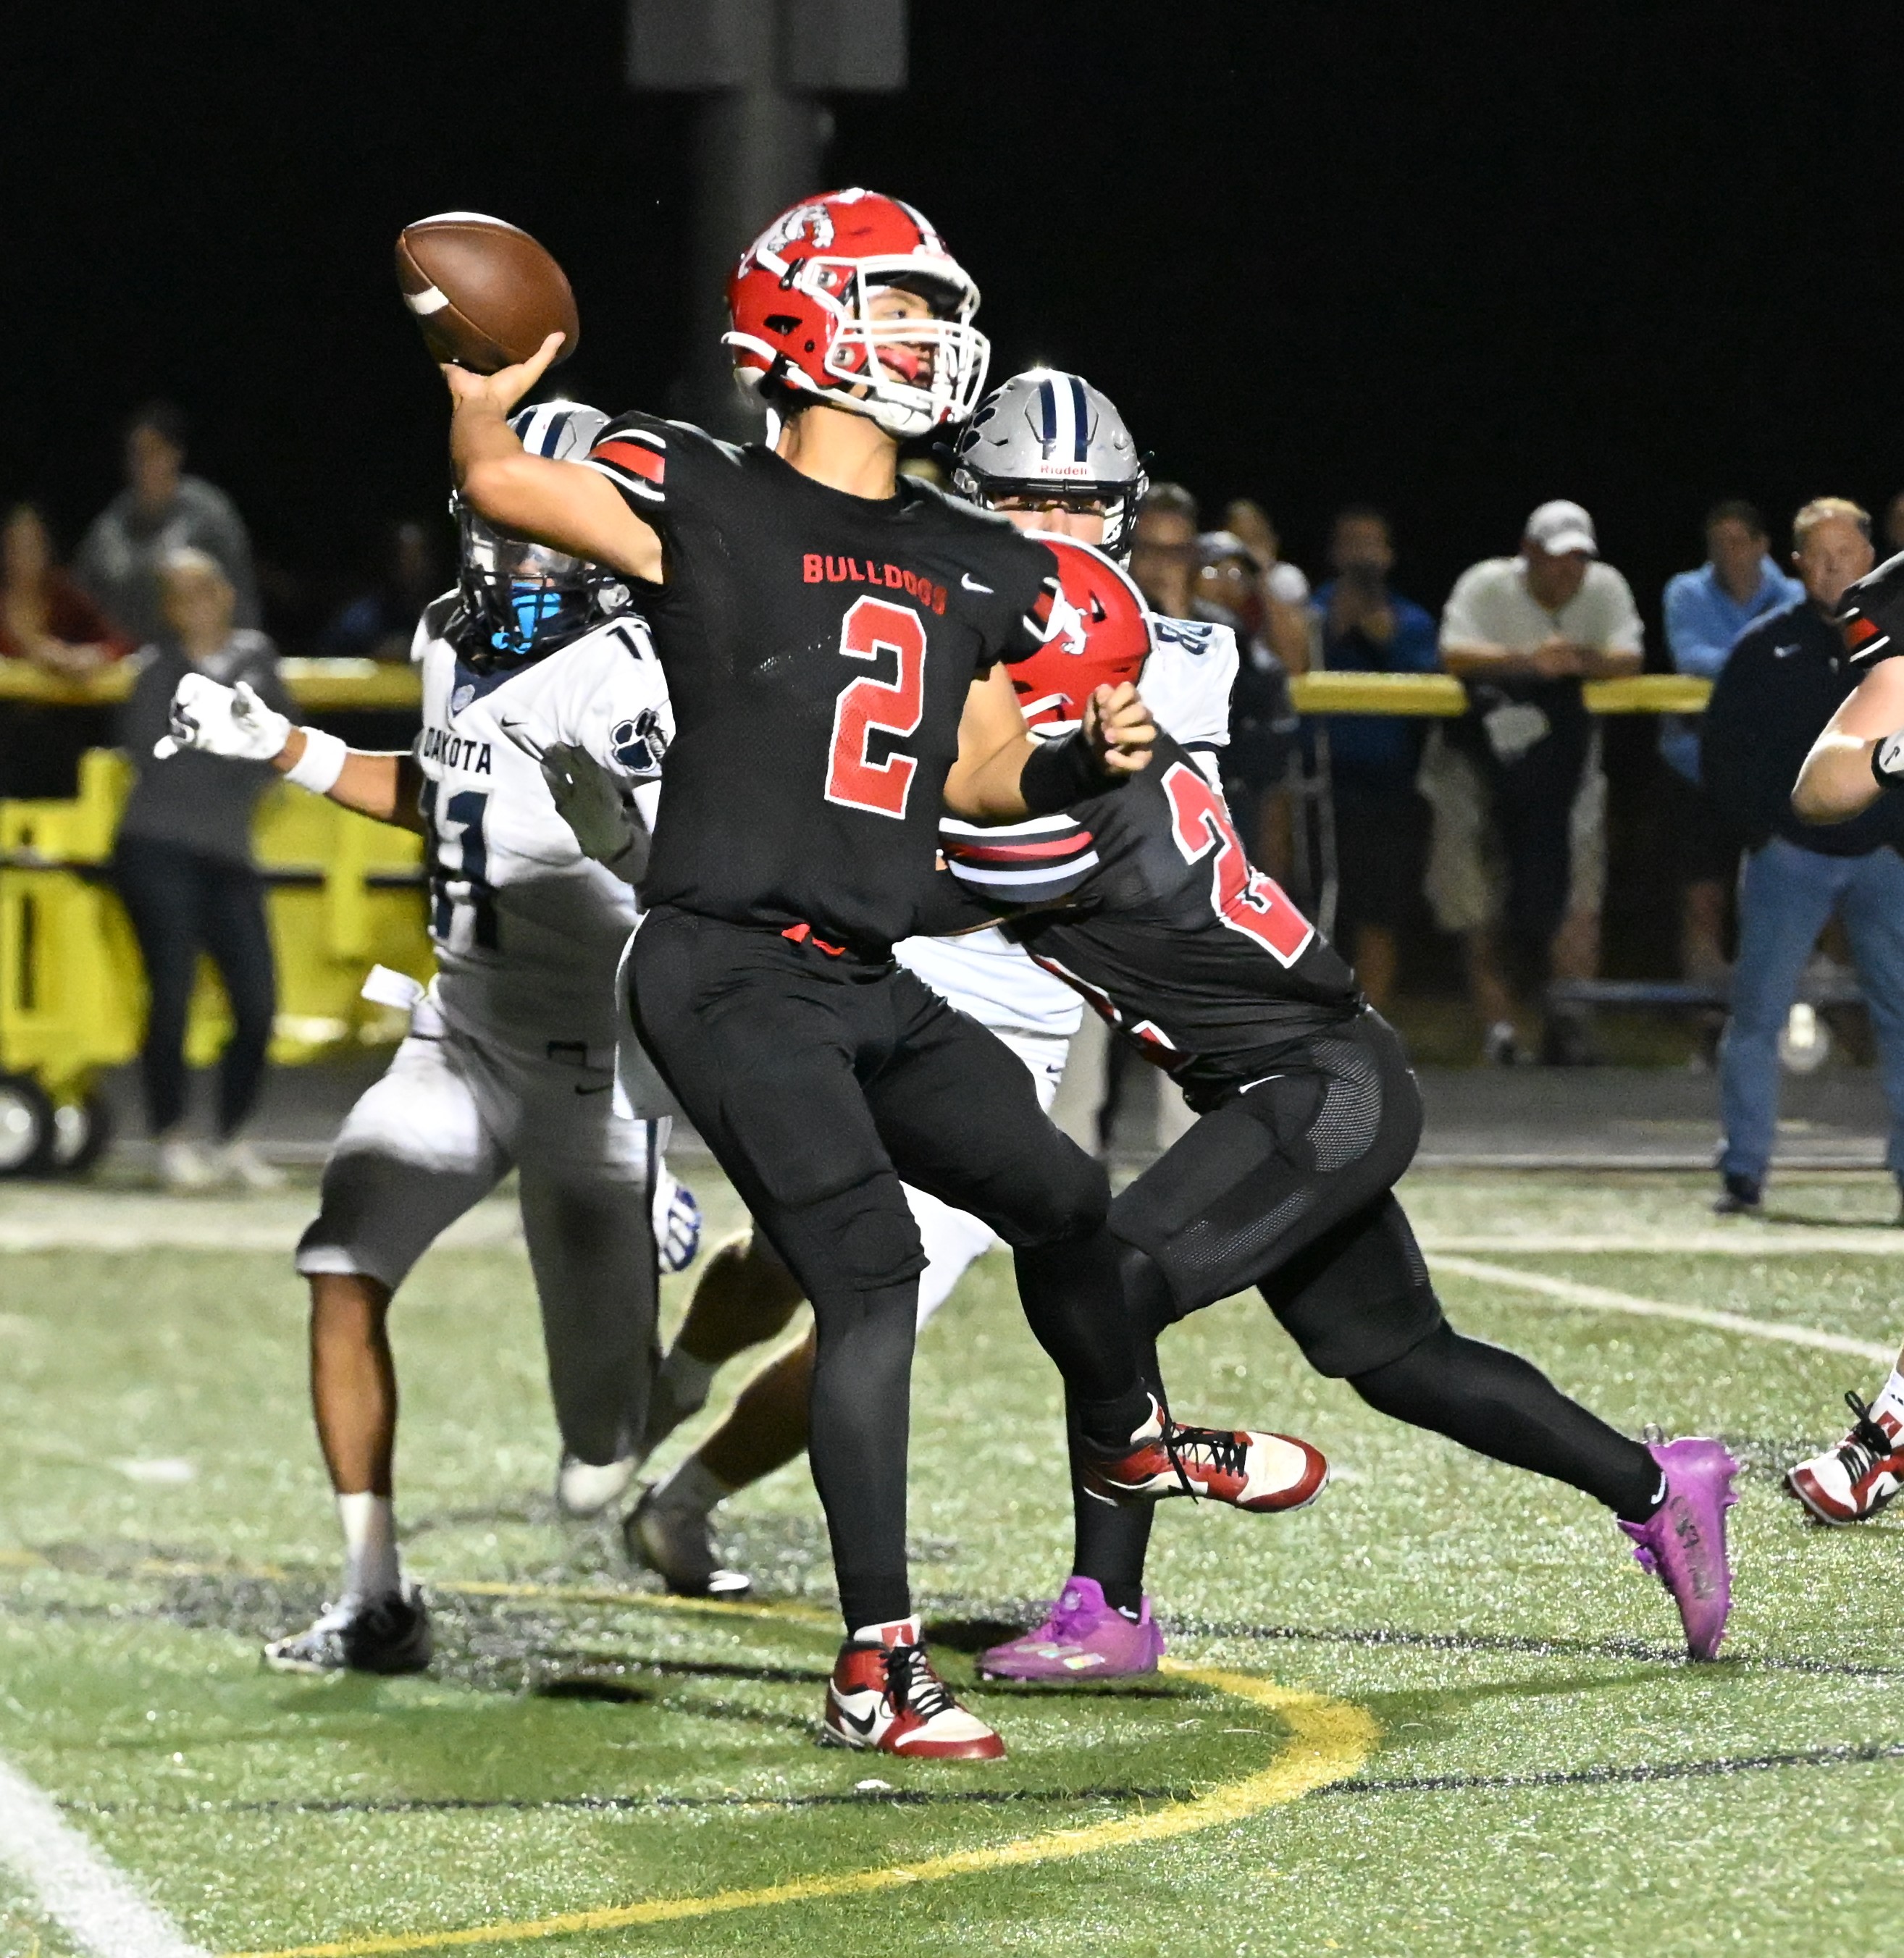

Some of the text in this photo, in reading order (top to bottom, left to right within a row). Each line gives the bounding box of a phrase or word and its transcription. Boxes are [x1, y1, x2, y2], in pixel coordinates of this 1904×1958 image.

[803, 553, 947, 615] BULLDOGS
[824, 594, 926, 819] 2
[423, 726, 491, 775] DAKOTA
